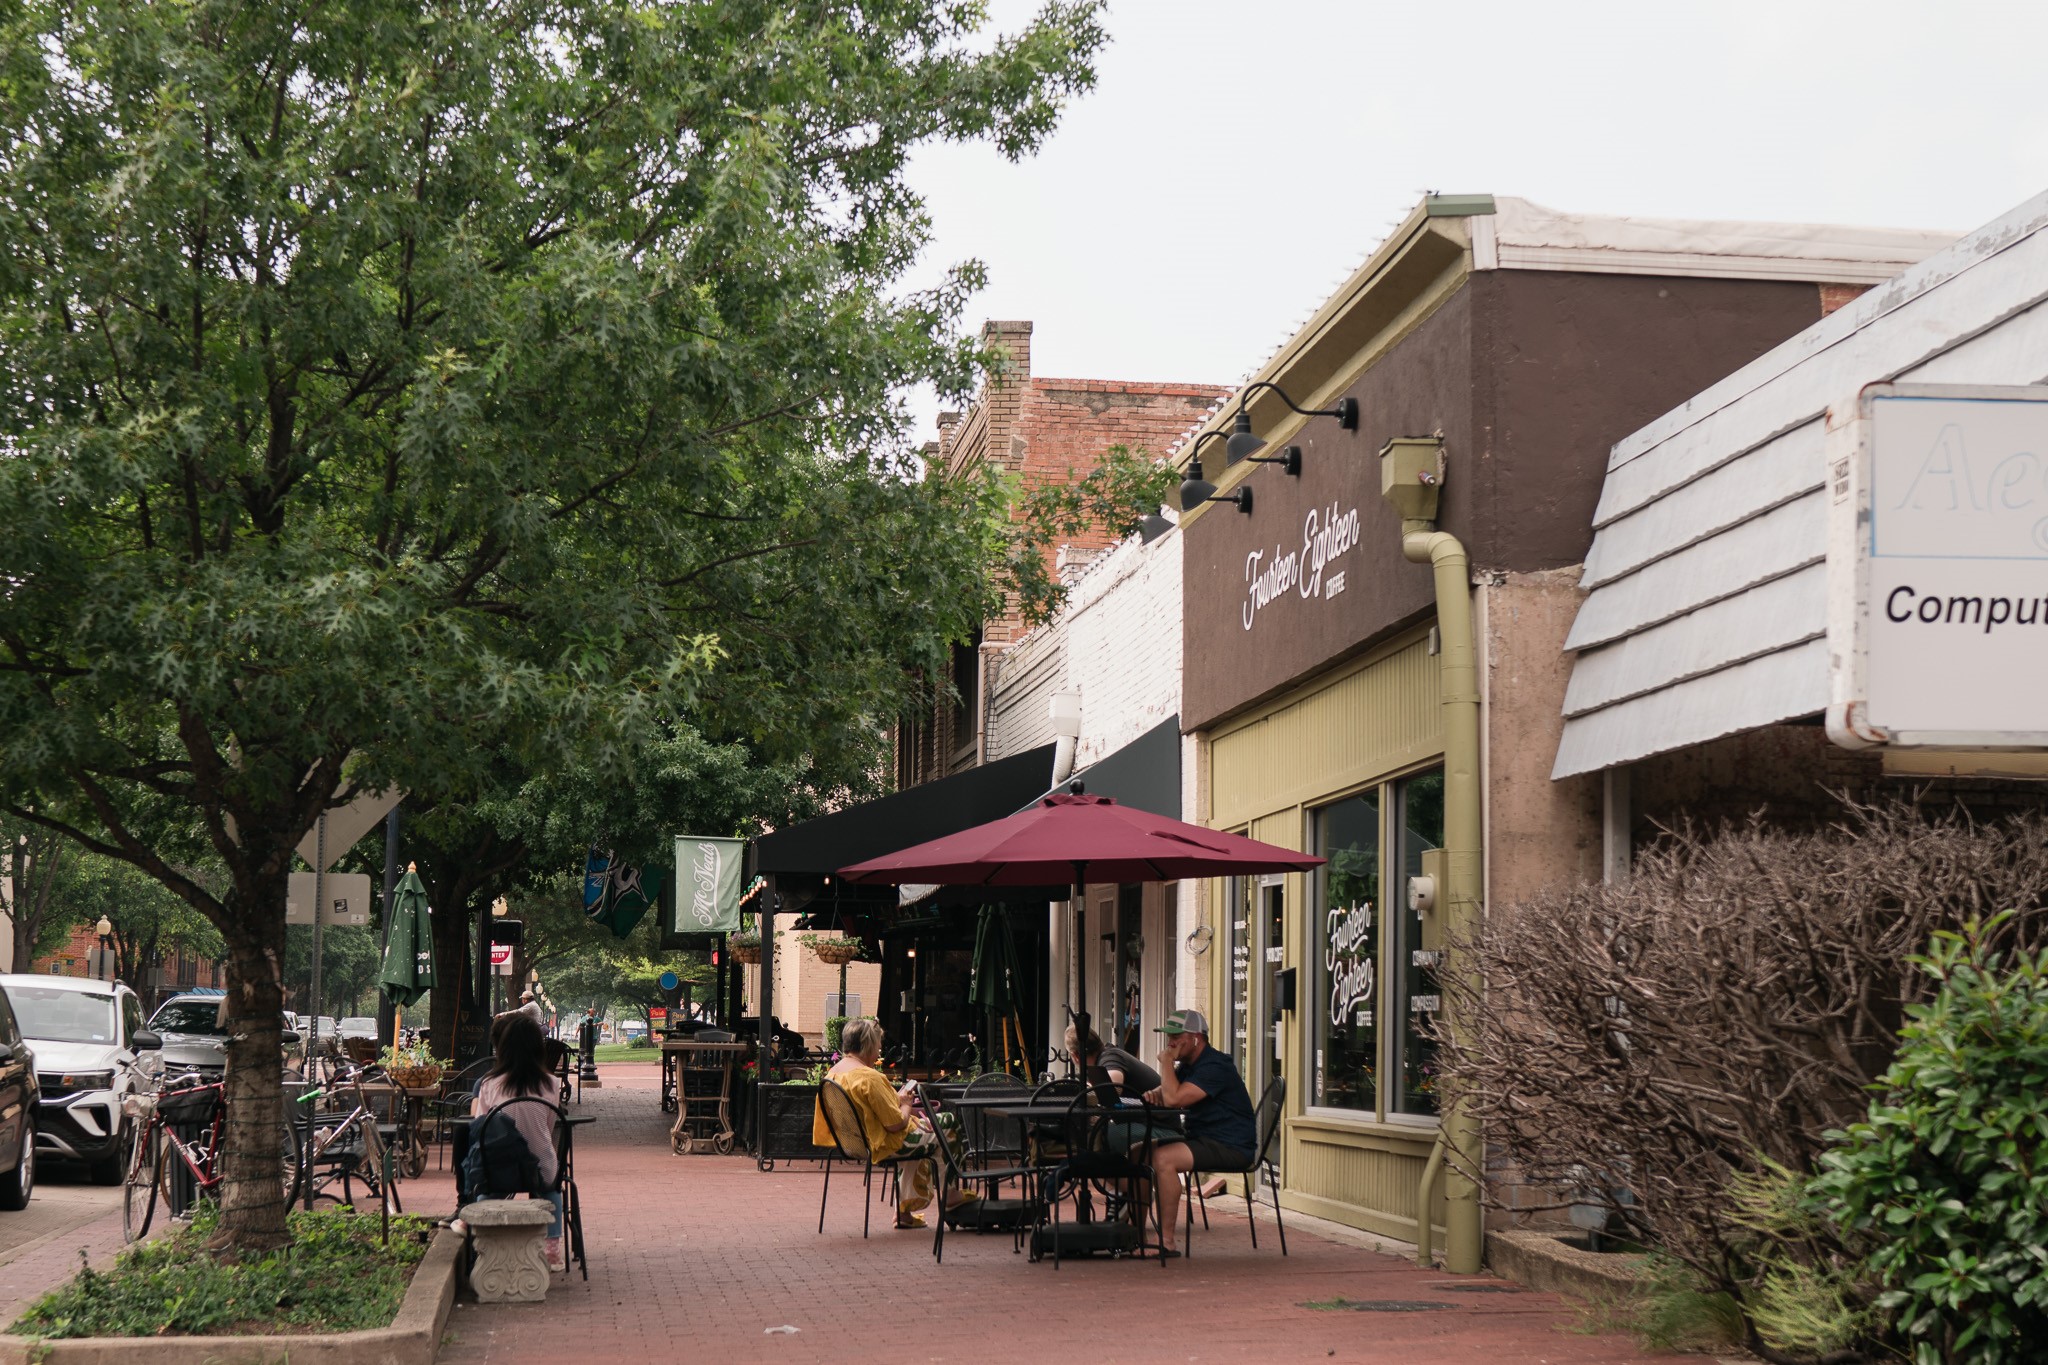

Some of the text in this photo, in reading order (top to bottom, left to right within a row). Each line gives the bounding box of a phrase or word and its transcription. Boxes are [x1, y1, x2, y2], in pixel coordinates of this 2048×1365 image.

[1242, 500, 1360, 631] Fourteen Eighteen
[1326, 571, 1345, 600] COFFEE
[1326, 900, 1371, 971] Fourteen
[1331, 954, 1374, 1025] Eighteen
[1356, 1011, 1372, 1026] COFFEE
